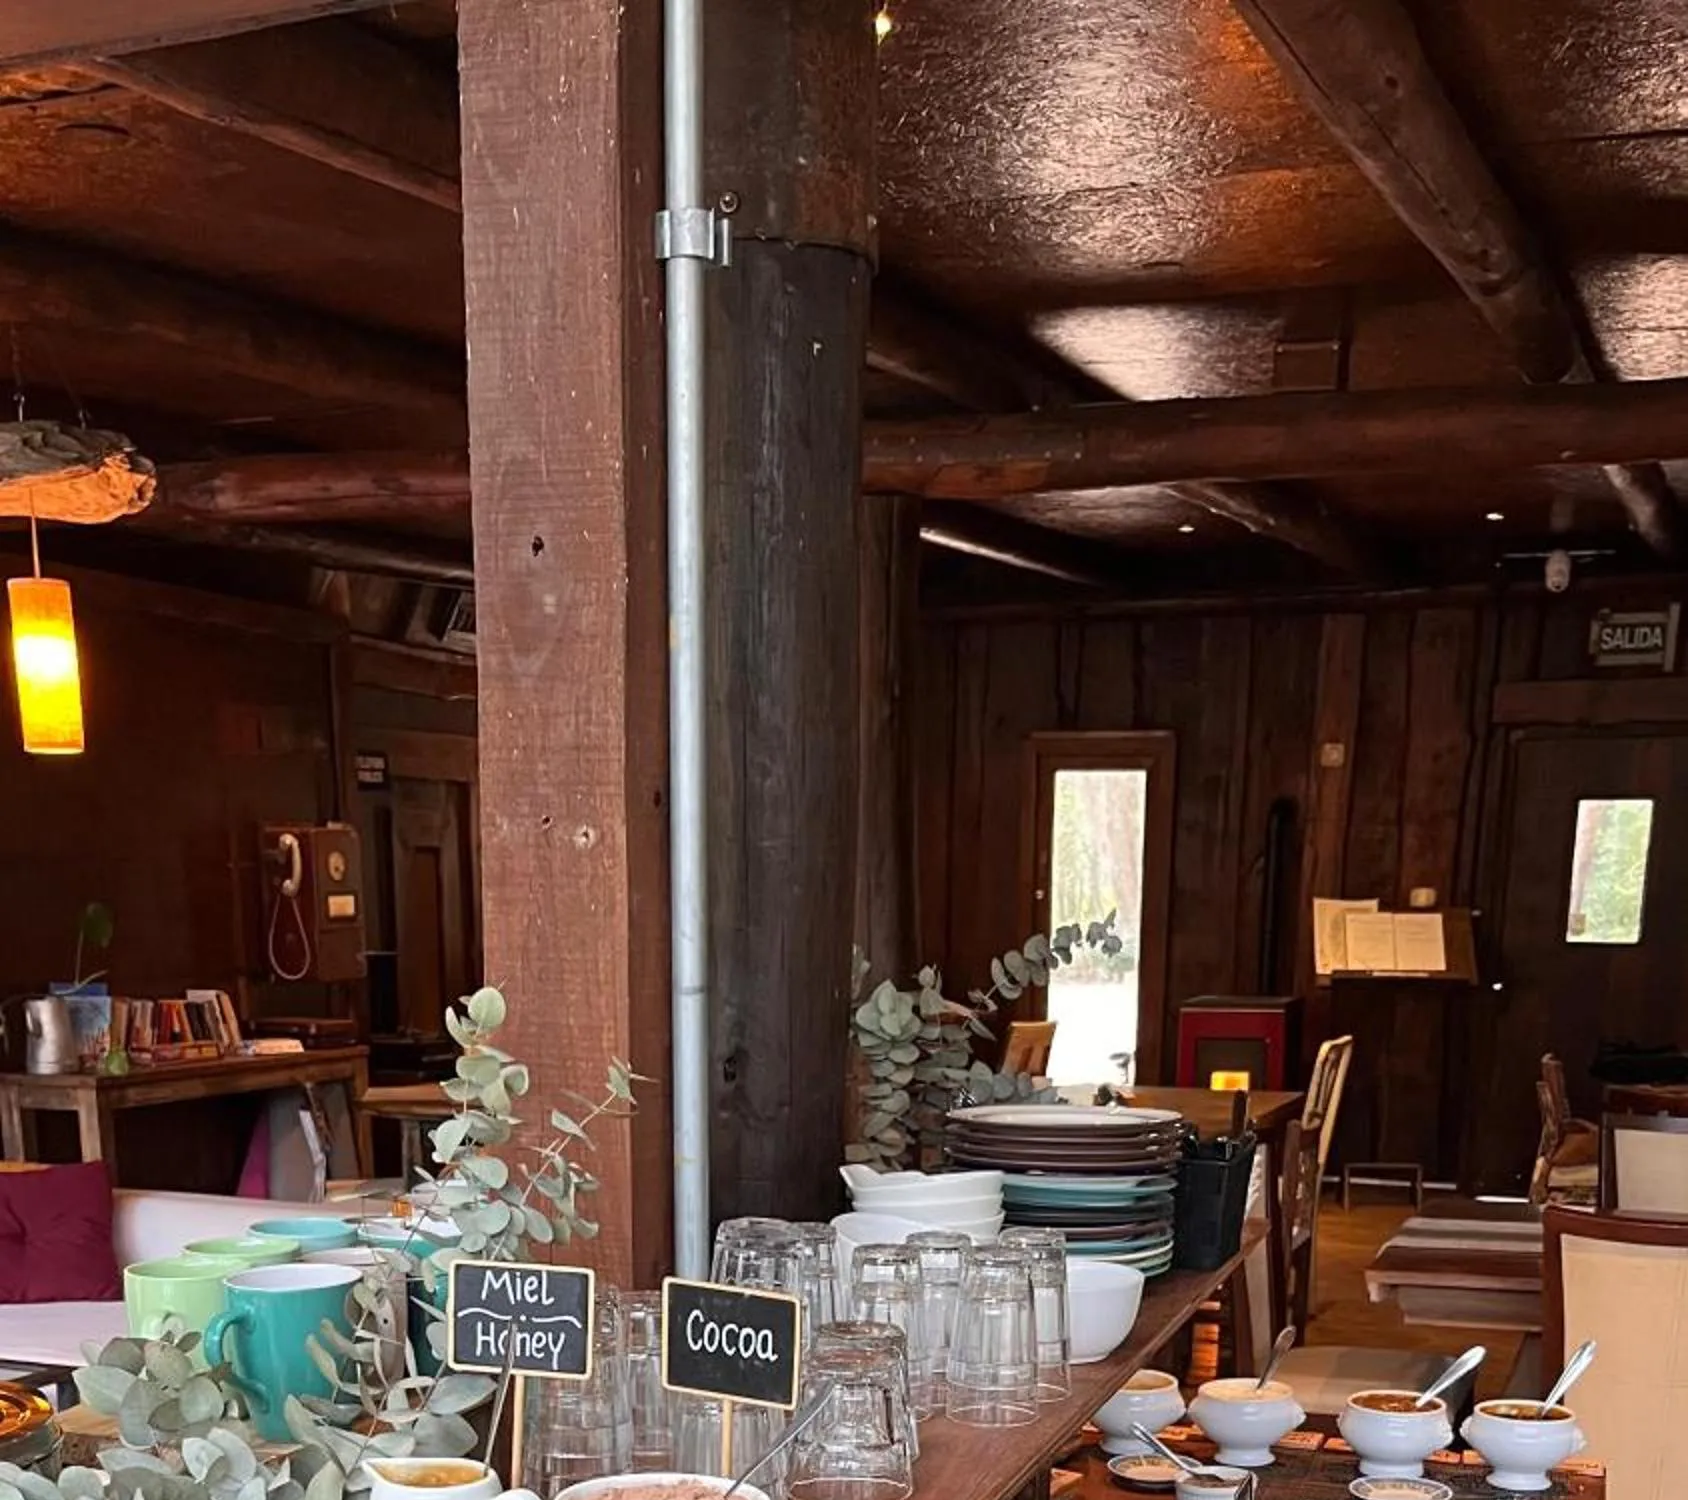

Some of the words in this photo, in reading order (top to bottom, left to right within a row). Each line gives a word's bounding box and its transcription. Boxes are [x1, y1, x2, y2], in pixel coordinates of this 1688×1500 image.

[1600, 626, 1663, 650] SALIDA
[481, 1270, 555, 1305] Miel
[475, 1320, 566, 1371] Honey
[685, 1308, 779, 1363] Cocoa
